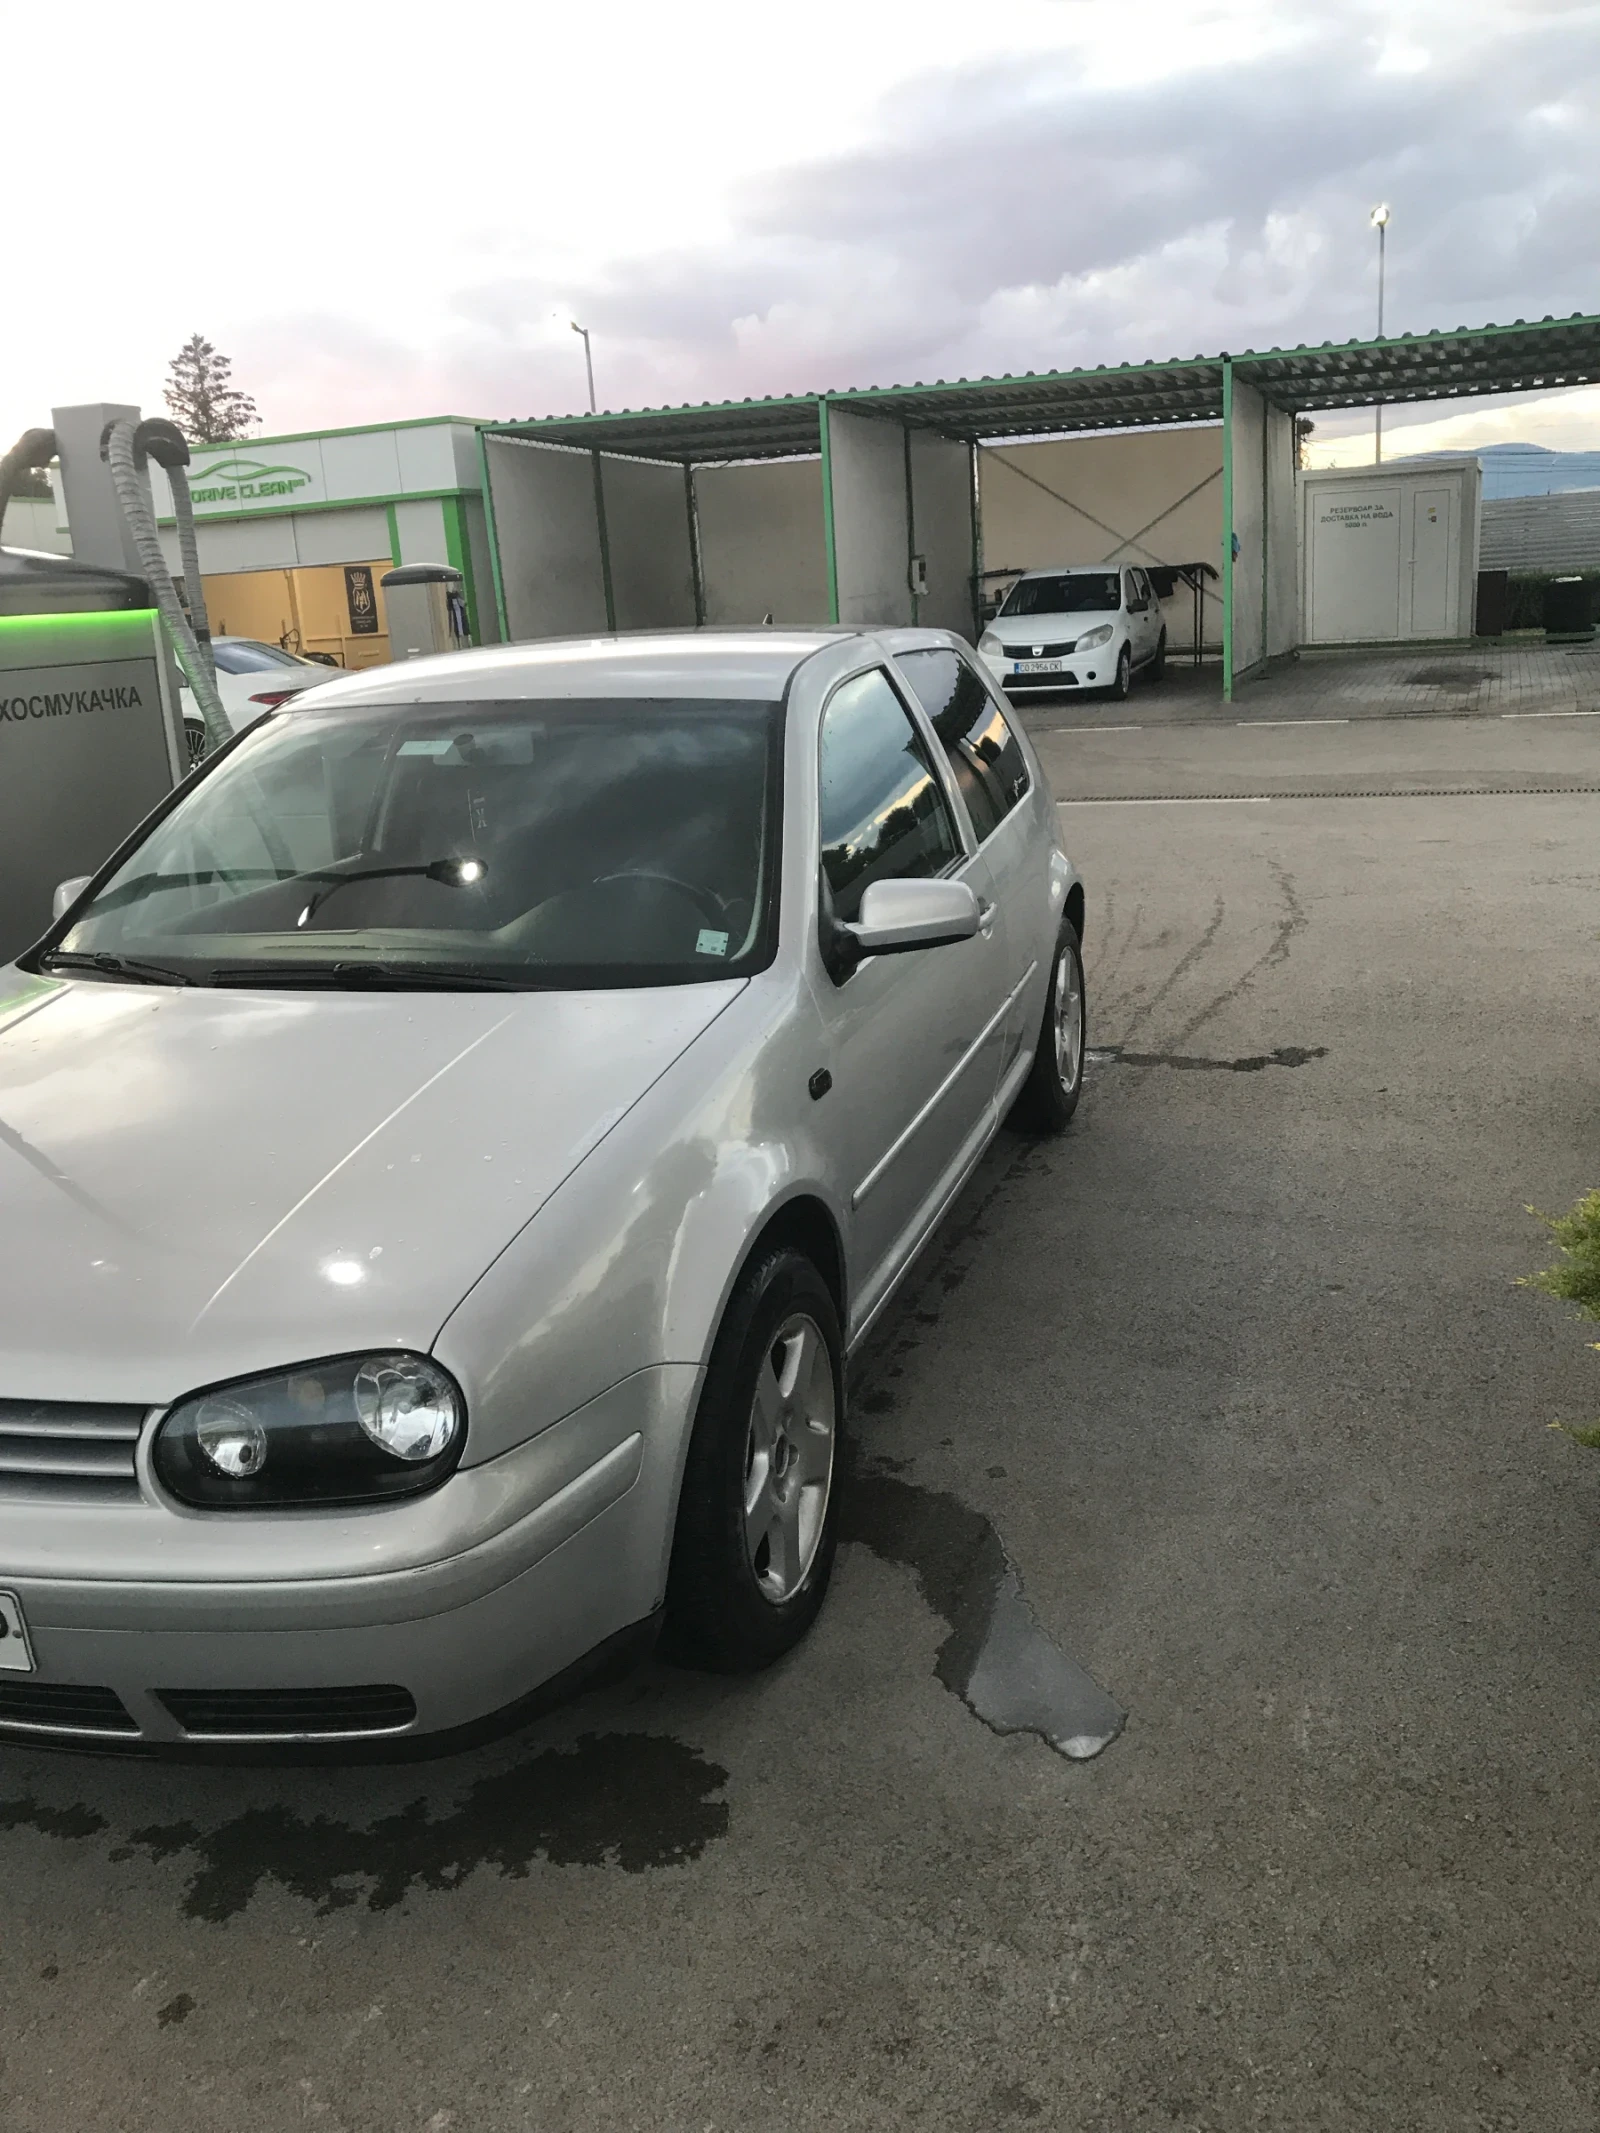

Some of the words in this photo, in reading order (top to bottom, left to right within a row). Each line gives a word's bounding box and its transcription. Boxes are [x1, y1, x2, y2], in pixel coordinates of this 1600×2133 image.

[191, 486, 238, 503] DRIVE
[240, 480, 294, 499] CLEAN
[1330, 505, 1373, 514] РЕЗЕРВОАР
[1320, 514, 1360, 523] ДОСТАВКА
[1372, 511, 1393, 519] ВОДА
[1030, 663, 1049, 672] 2956
